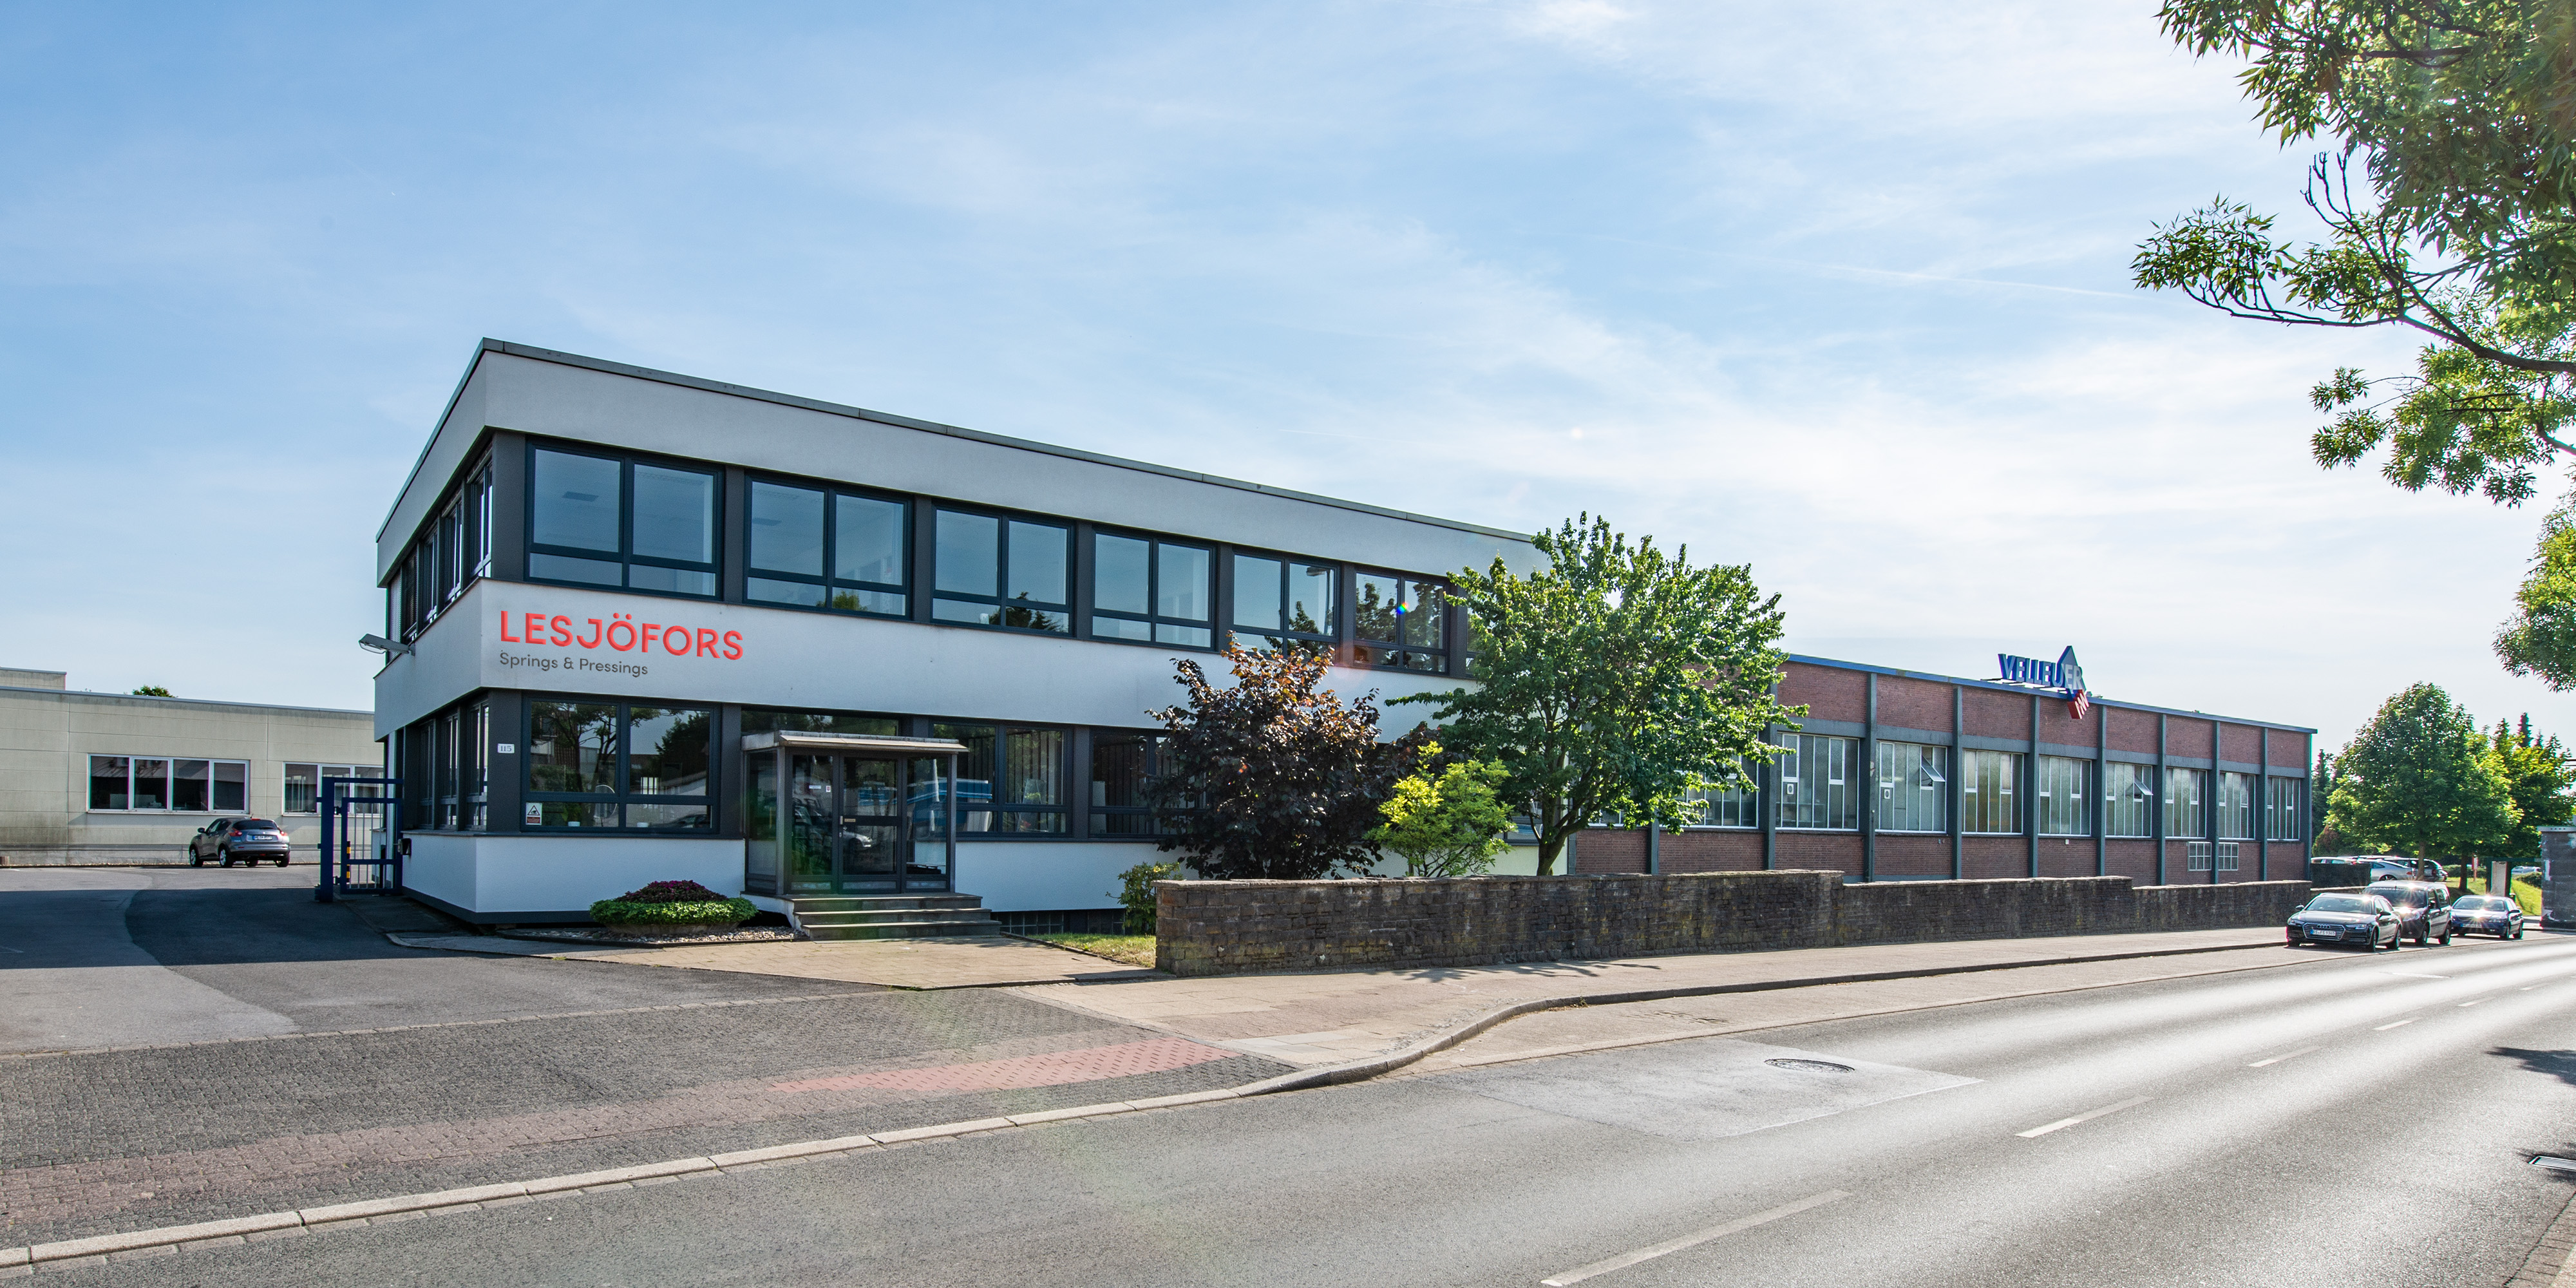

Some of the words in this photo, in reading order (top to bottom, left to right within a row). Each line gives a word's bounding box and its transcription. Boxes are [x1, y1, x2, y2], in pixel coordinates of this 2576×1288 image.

[501, 611, 744, 660] LESJÖFORS
[500, 652, 558, 671] Springs
[564, 657, 574, 670] &
[580, 658, 649, 678] Pressings
[1998, 654, 2083, 690] VELLEUER
